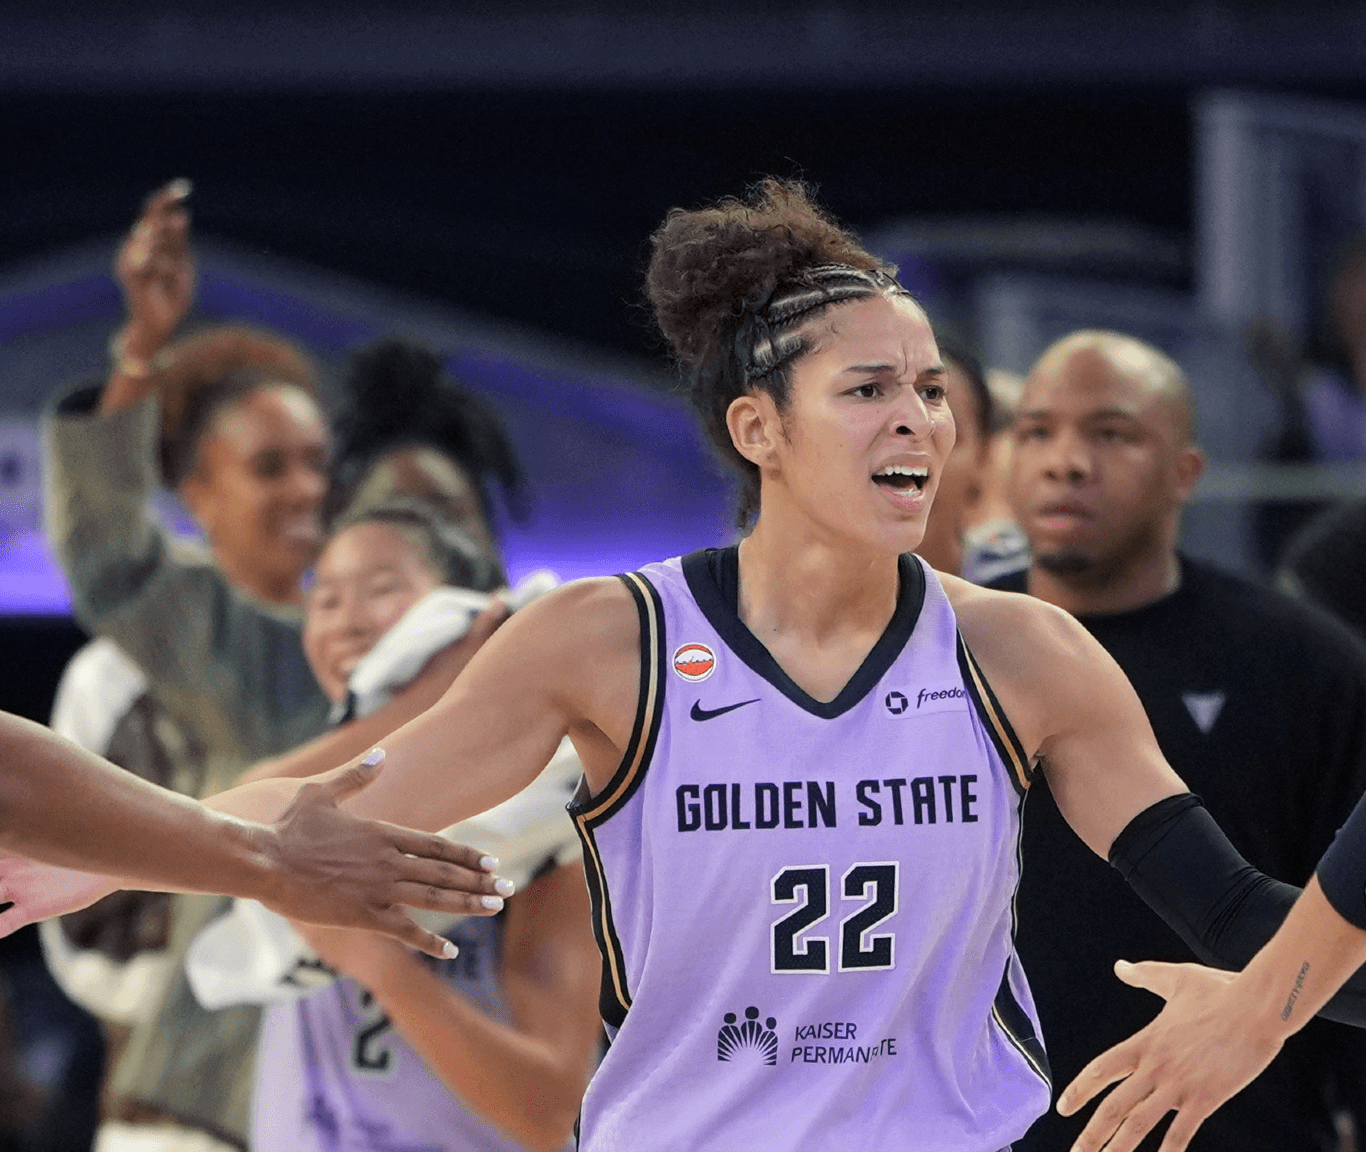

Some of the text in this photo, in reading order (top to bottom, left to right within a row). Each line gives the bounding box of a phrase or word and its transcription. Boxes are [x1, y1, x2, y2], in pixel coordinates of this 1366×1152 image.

[916, 687, 968, 709] freedo
[675, 774, 979, 832] GOLDEN STATE
[769, 860, 900, 975] 22
[795, 1022, 857, 1041] KAISER
[791, 1038, 897, 1064] PERMANTE
